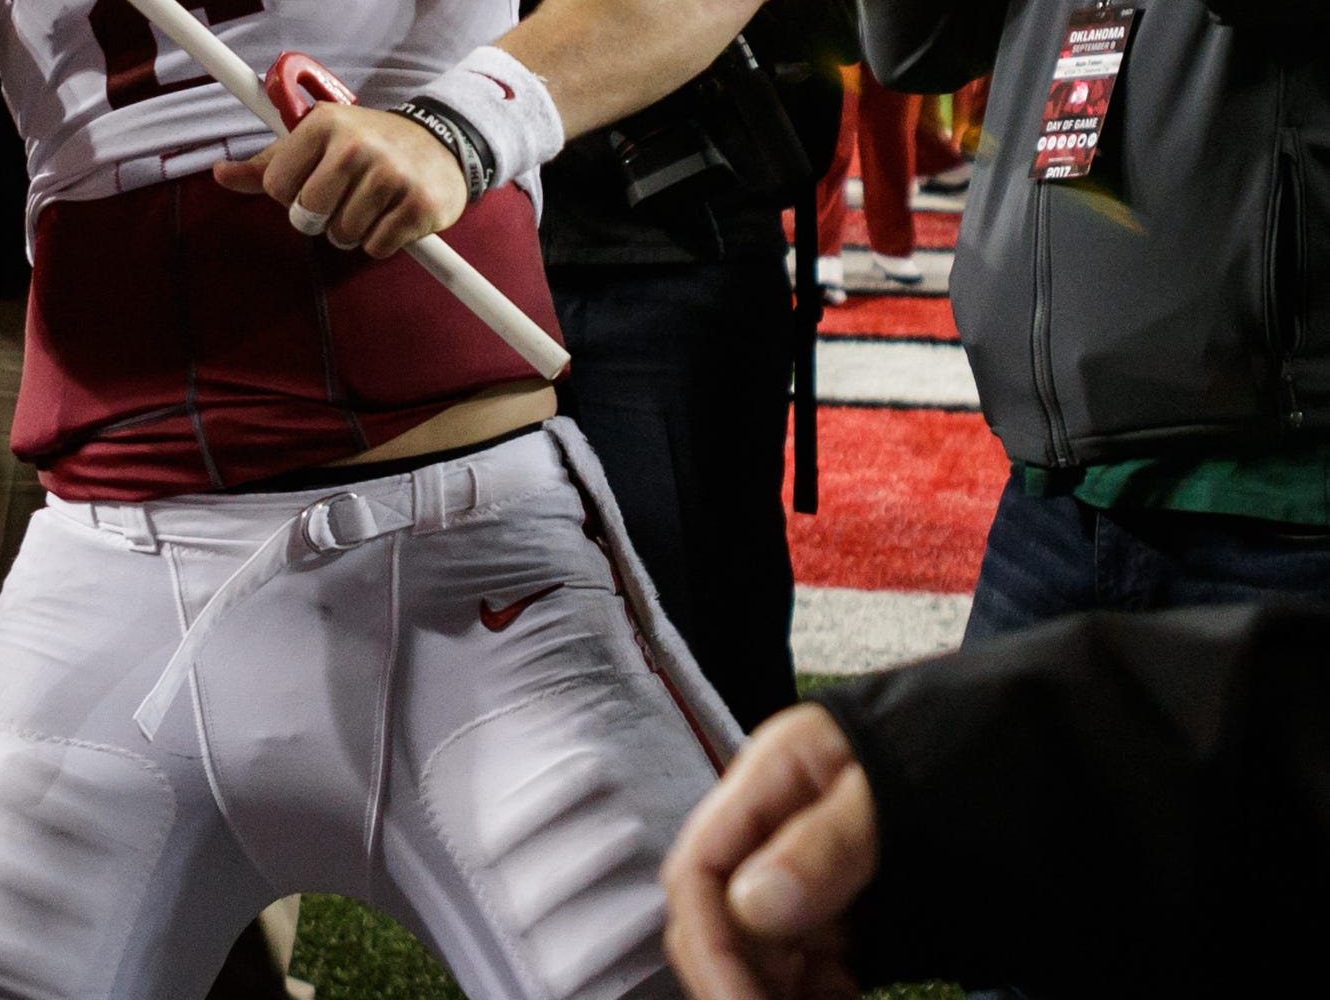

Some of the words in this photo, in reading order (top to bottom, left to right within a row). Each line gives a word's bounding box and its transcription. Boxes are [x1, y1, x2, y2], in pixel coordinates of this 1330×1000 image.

[1070, 26, 1125, 43] OKLAHOMA
[1072, 42, 1110, 54] SEPTEMBER
[1046, 120, 1062, 132] DAY
[1062, 119, 1074, 130] OF
[1074, 117, 1099, 129] GAME
[1045, 165, 1072, 179] 2017
